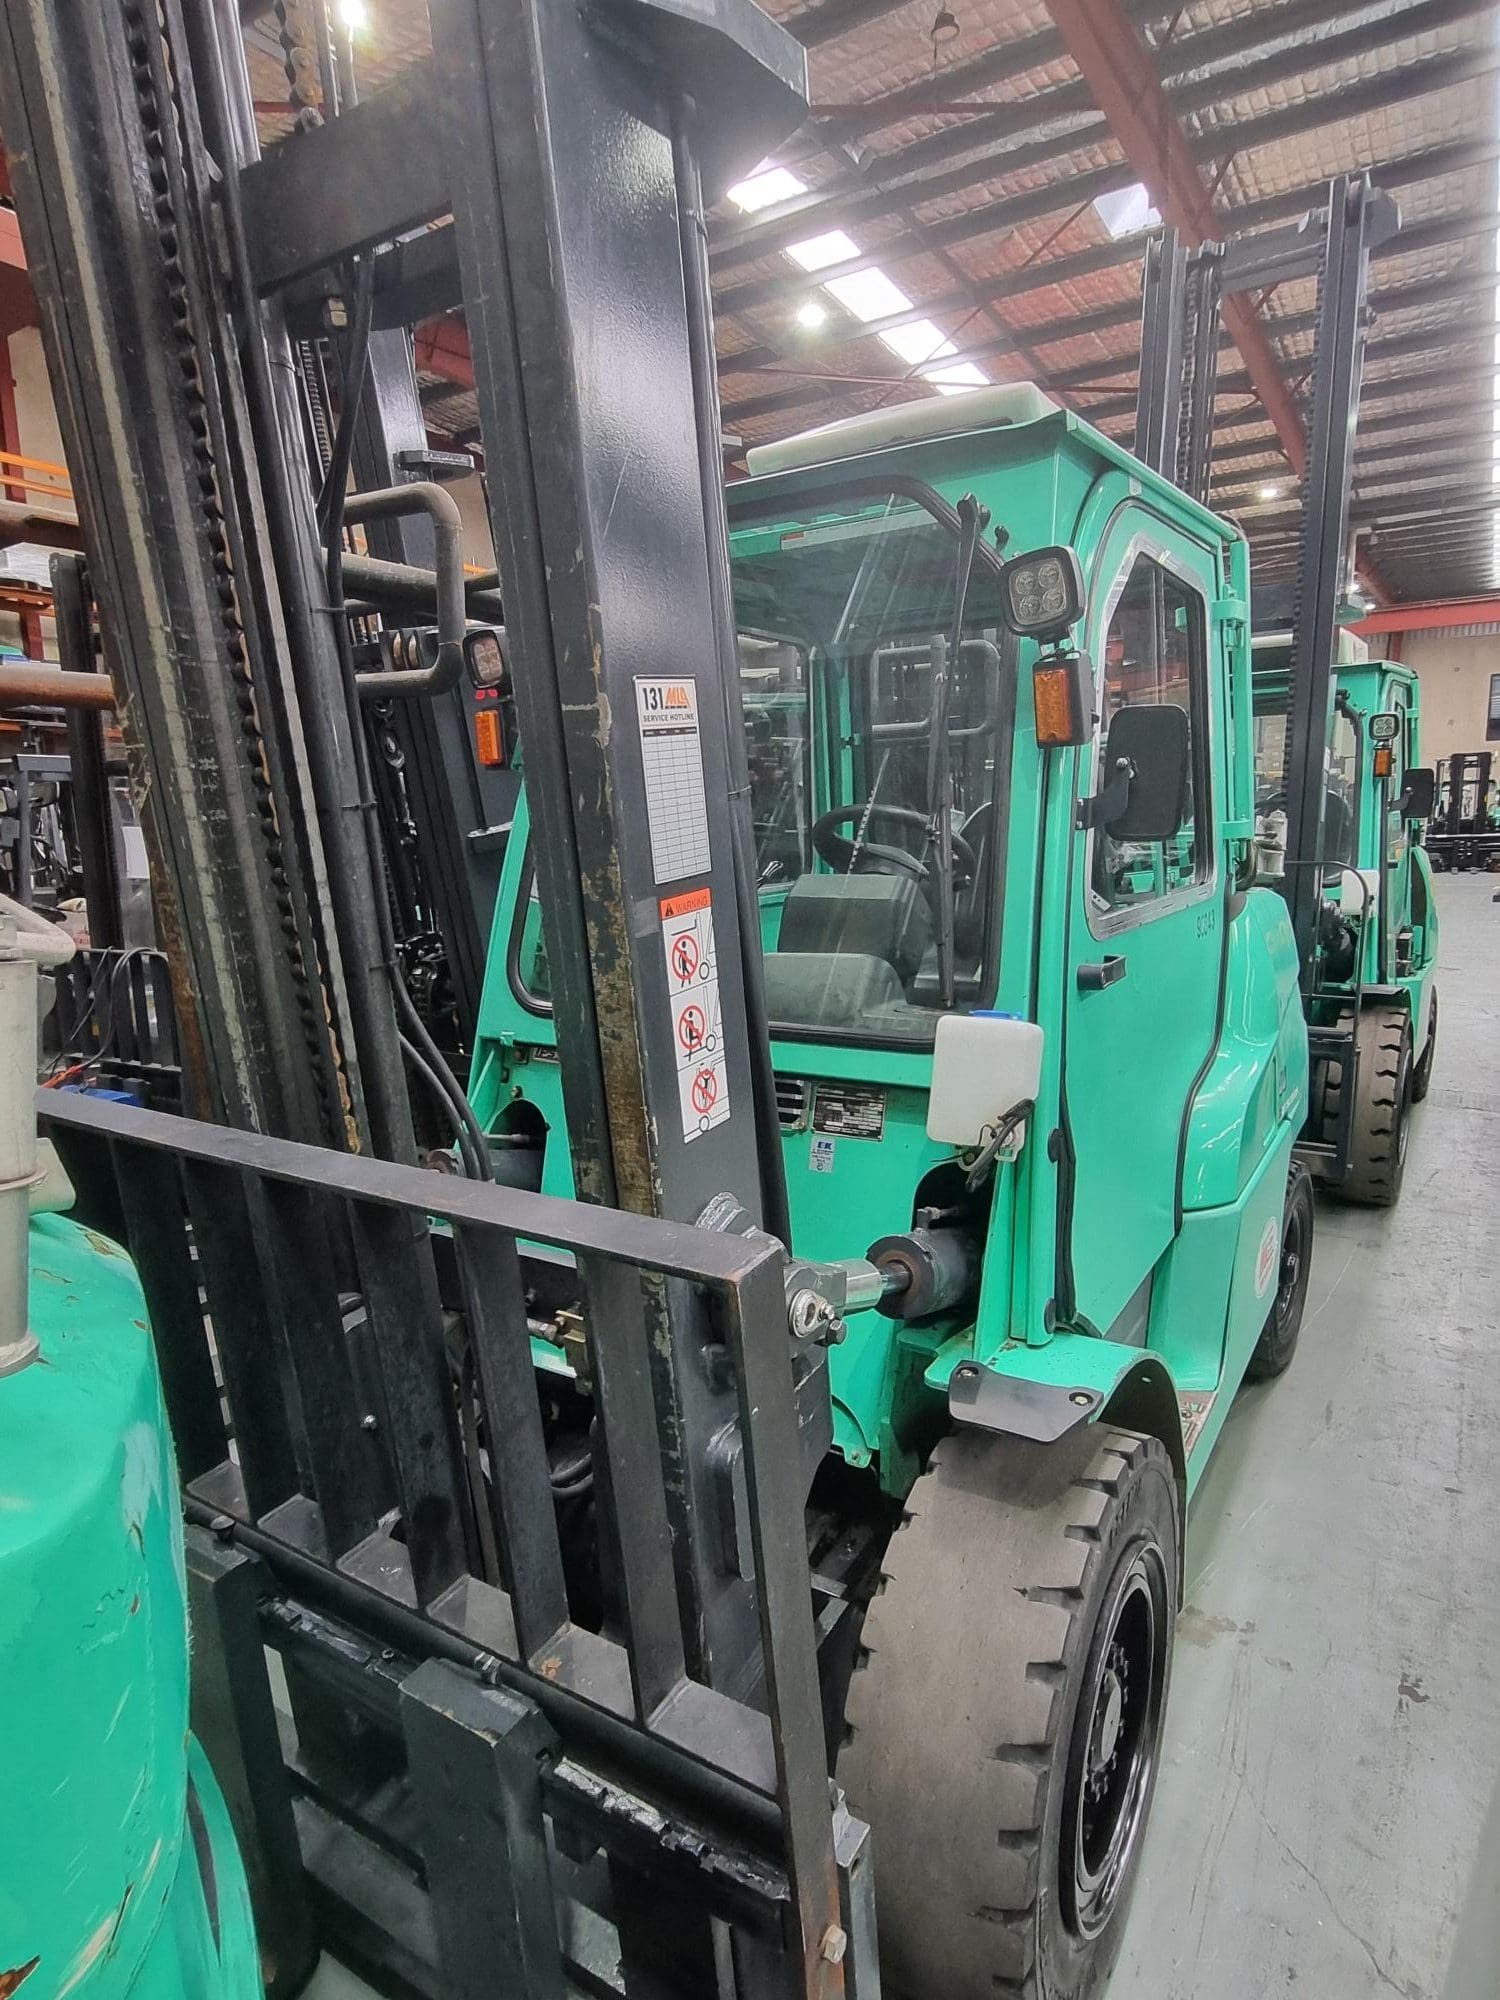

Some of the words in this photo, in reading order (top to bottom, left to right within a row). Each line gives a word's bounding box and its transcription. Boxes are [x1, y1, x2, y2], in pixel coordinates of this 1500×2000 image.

[643, 687, 664, 710] 131
[643, 714, 669, 722] SERVICE
[670, 713, 695, 721] HOTLINE
[675, 895, 708, 913] WARNING
